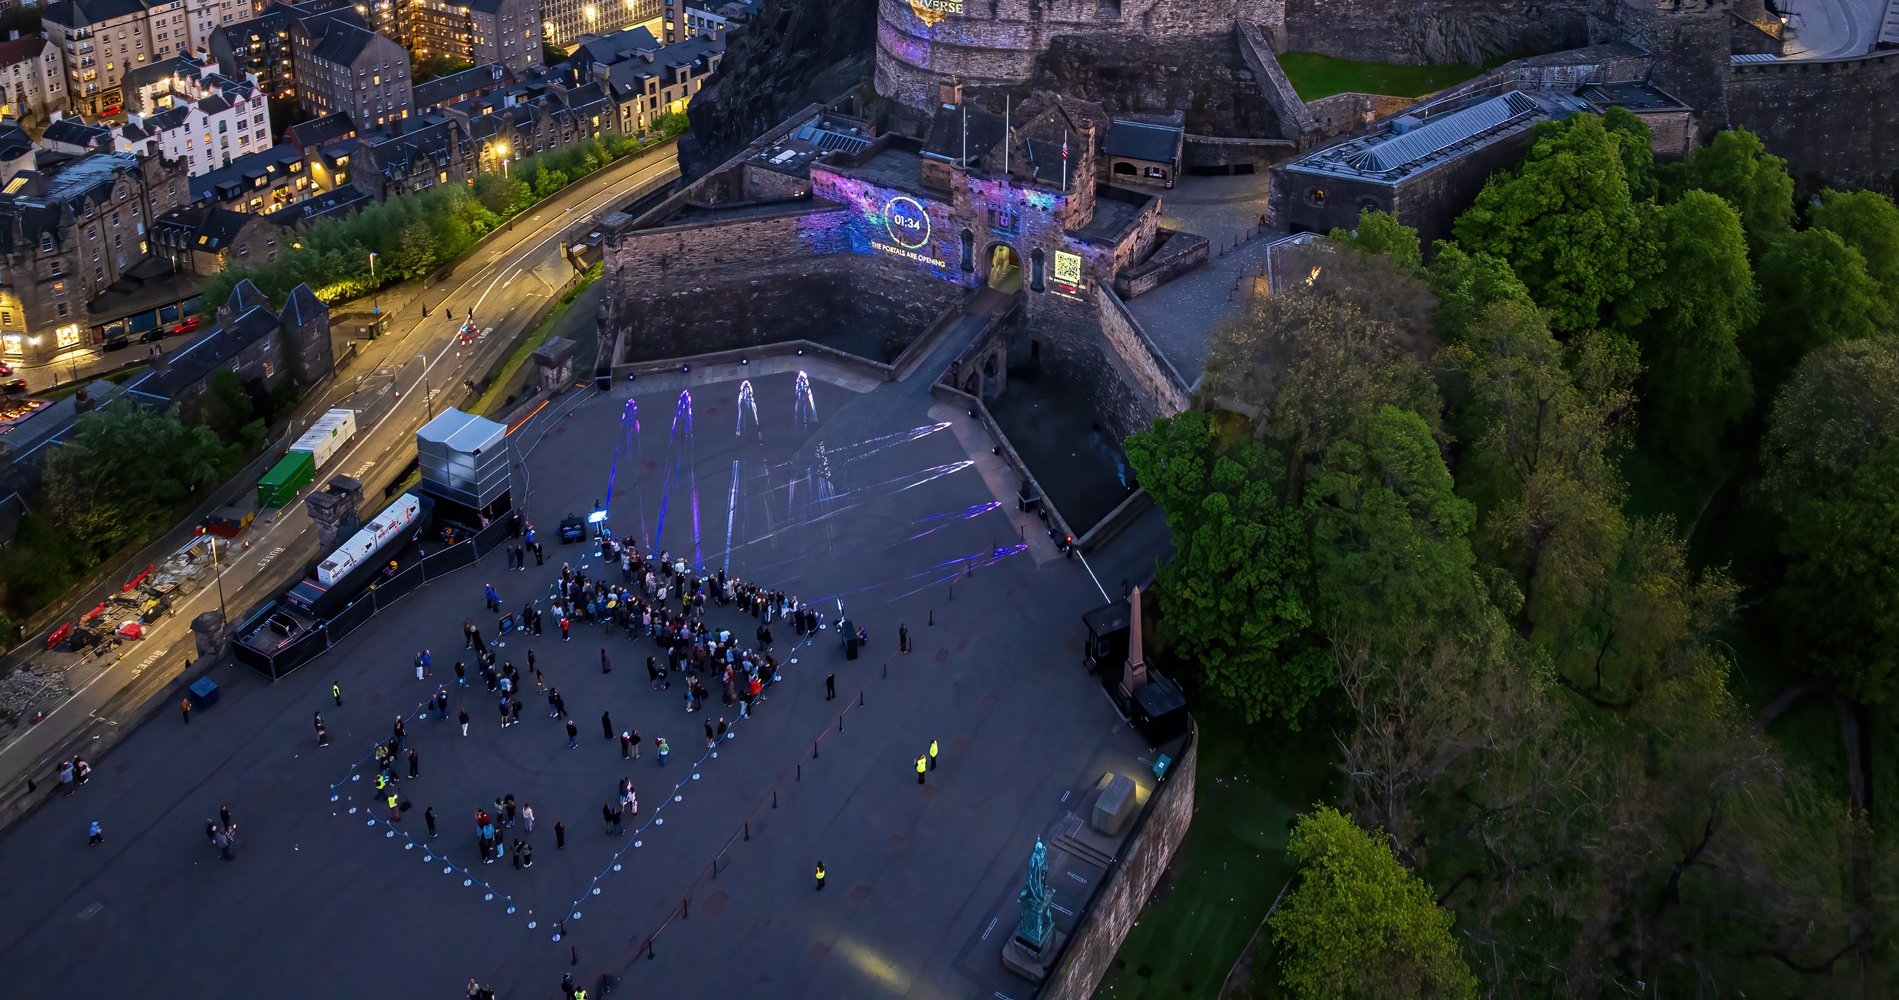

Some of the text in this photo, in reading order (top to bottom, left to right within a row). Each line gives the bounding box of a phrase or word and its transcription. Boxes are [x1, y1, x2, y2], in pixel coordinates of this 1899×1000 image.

[894, 214, 921, 230] 01:34
[871, 241, 946, 268] THE PORTALS ARE OPENING
